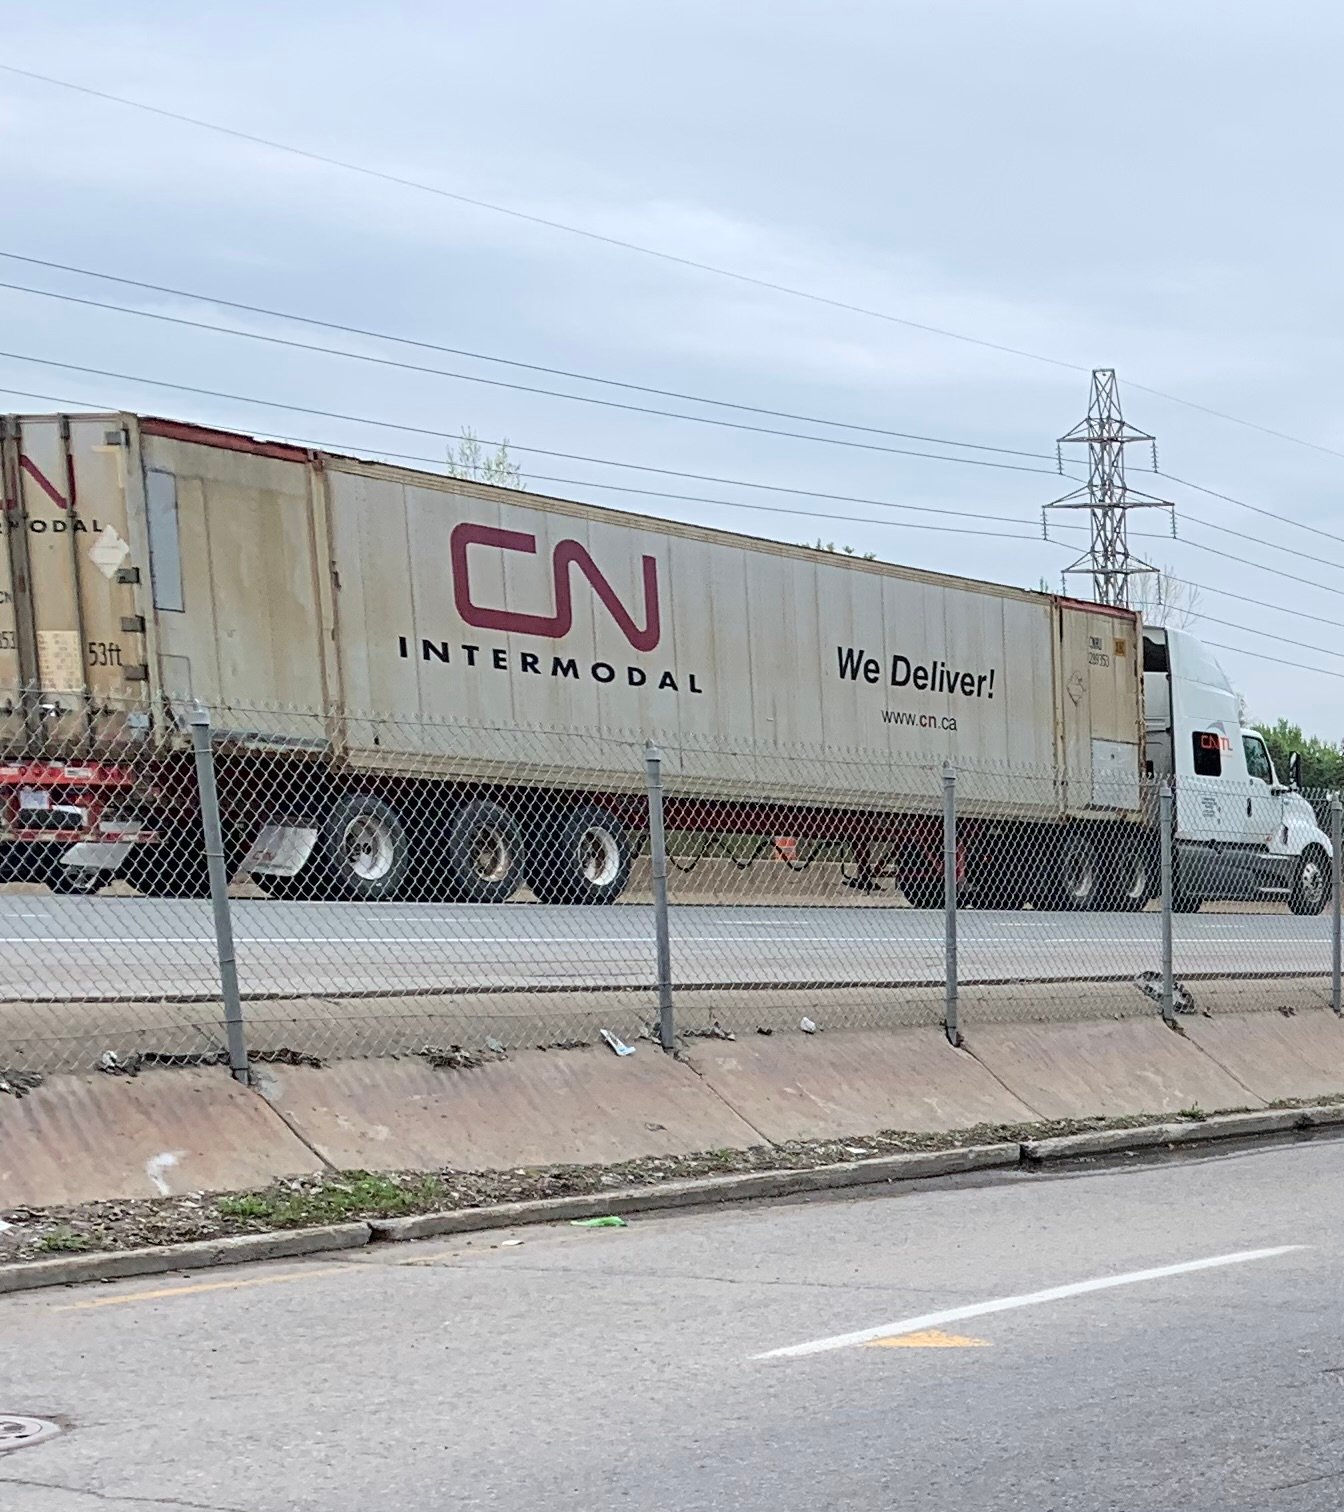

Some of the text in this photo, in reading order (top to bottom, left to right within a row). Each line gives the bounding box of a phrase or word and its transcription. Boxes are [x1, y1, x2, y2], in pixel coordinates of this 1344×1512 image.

[3, 454, 76, 510] N
[451, 523, 660, 652] CN
[88, 642, 123, 666] 53ft
[399, 636, 703, 694] INTERMODAL
[837, 646, 995, 699] We Deliver!
[881, 709, 957, 732] www.cn.ca
[1201, 734, 1234, 752] CNTL
